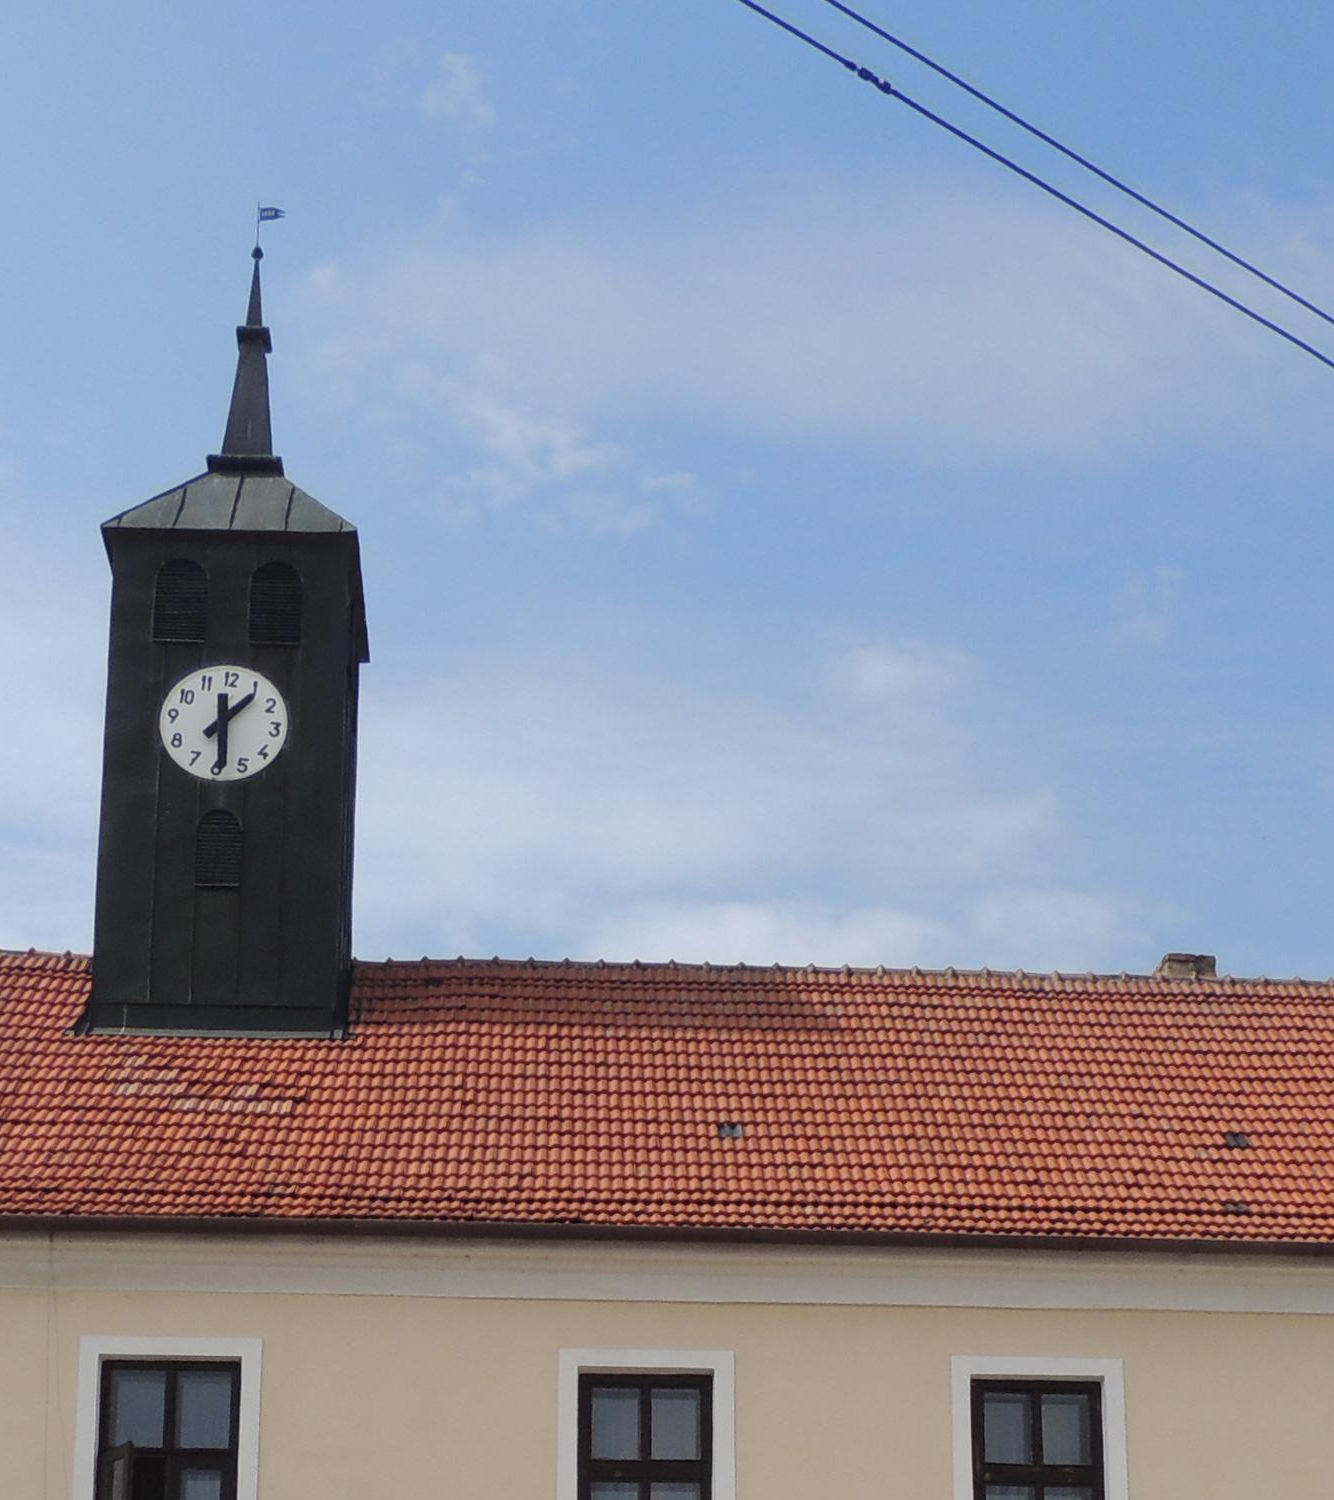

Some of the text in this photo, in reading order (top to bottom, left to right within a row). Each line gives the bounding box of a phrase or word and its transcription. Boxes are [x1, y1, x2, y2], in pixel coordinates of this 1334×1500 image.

[200, 675, 213, 692] 11
[224, 671, 240, 688] 12
[178, 688, 195, 705] 10
[264, 697, 277, 714] 2
[167, 707, 180, 724] 9
[268, 721, 282, 738] 3
[170, 732, 183, 748] 8
[188, 749, 202, 767] 7
[257, 744, 269, 760] 4
[236, 757, 249, 773] 5
